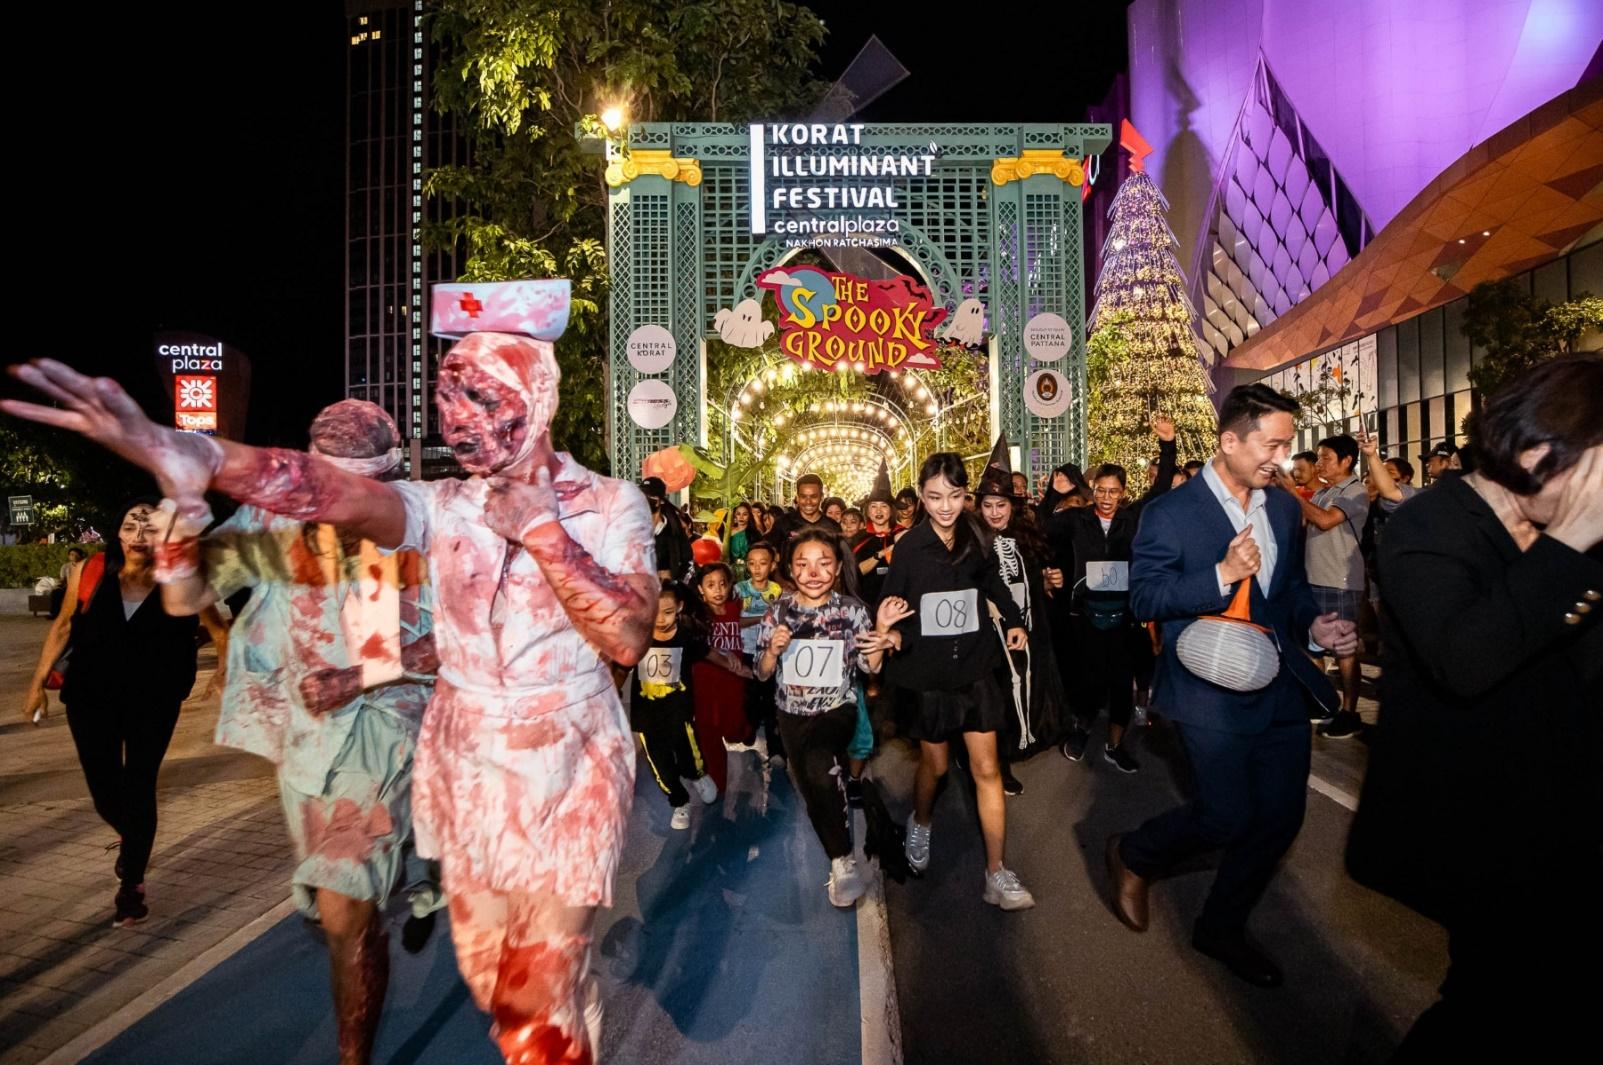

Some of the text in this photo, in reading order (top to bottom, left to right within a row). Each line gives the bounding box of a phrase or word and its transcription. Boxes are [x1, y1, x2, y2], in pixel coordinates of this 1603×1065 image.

[772, 124, 865, 145] KORAT
[772, 155, 936, 177] ILLUMINANT
[773, 187, 899, 209] FESTIVAL
[774, 215, 899, 237] centralplaza
[786, 238, 898, 248] NAKHON RATCHASIMA
[831, 276, 869, 305] THE
[158, 342, 222, 357] central
[630, 342, 672, 350] CENTRAL
[637, 349, 665, 357] KORAT
[785, 330, 908, 369] GROUND
[172, 355, 222, 374] plaza
[935, 599, 967, 628] 08
[646, 653, 673, 678] 03
[795, 645, 834, 678] 07
